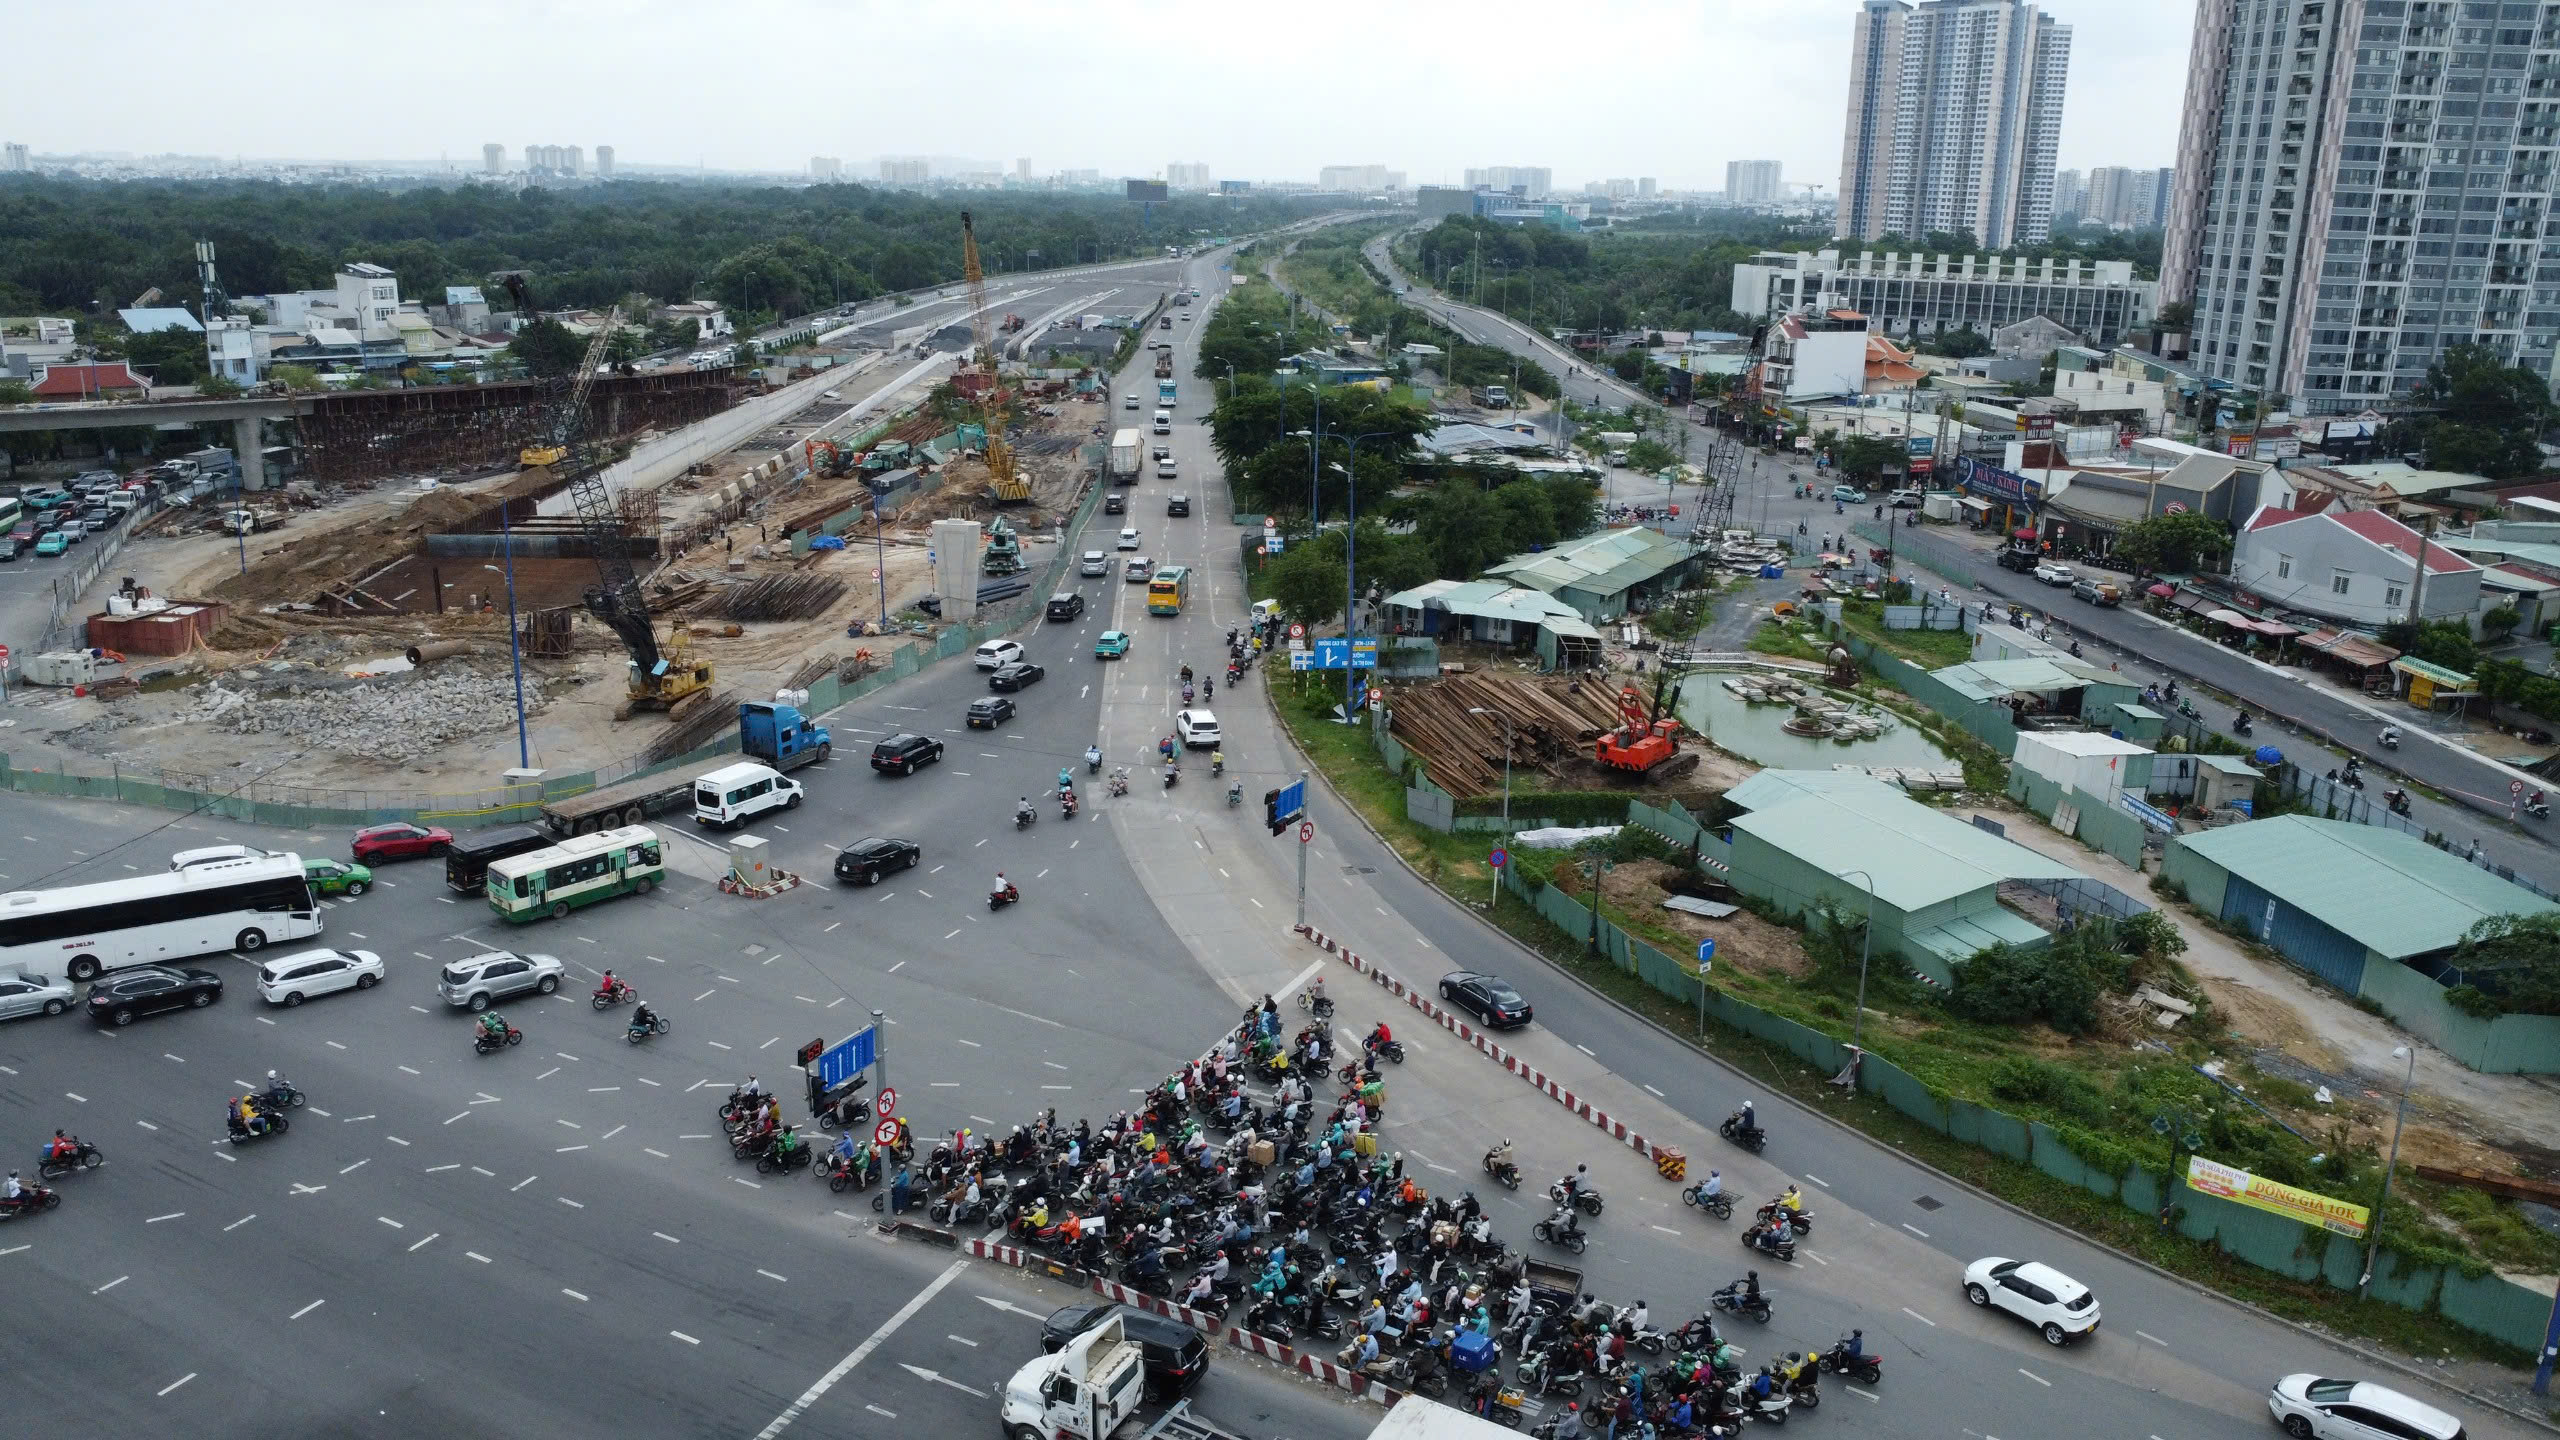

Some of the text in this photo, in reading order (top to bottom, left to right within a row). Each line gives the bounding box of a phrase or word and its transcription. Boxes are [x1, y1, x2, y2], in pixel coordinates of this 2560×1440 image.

[1997, 474, 2019, 493] KÍNH
[2299, 1195, 2325, 1211] GIÁ
[2328, 1203, 2358, 1220] 10K
